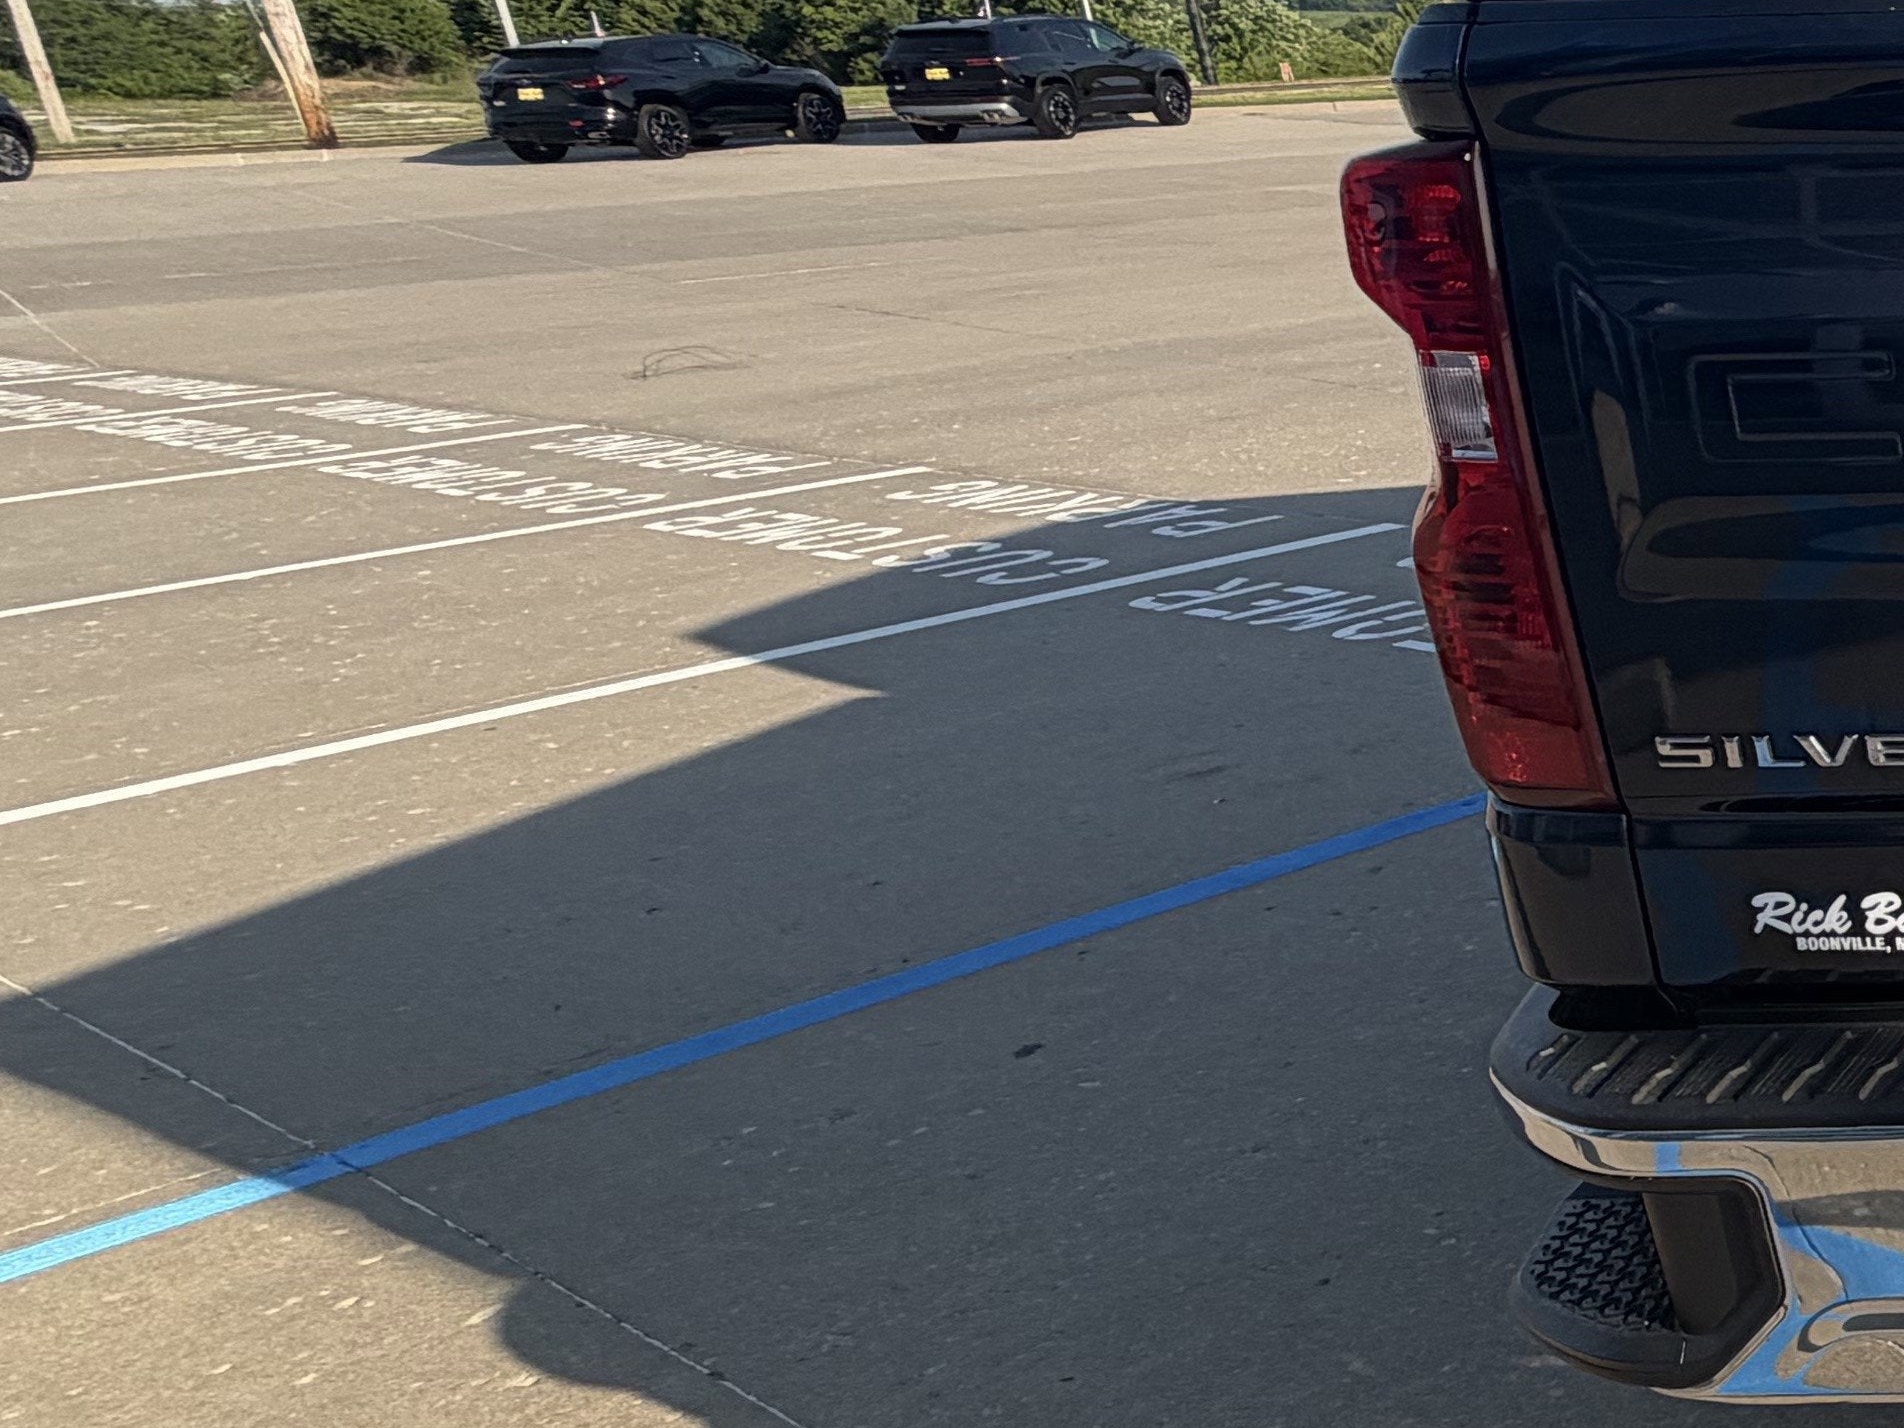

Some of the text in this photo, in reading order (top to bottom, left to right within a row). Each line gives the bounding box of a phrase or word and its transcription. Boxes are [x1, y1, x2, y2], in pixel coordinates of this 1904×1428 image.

[530, 434, 832, 479] PARKING
[316, 455, 668, 514] CUSTOMER
[886, 480, 1284, 538] PARKING
[642, 508, 1109, 586] CUSTOMER
[1751, 891, 1852, 935] Rick
[1796, 936, 1892, 954] BOONVILLE,
